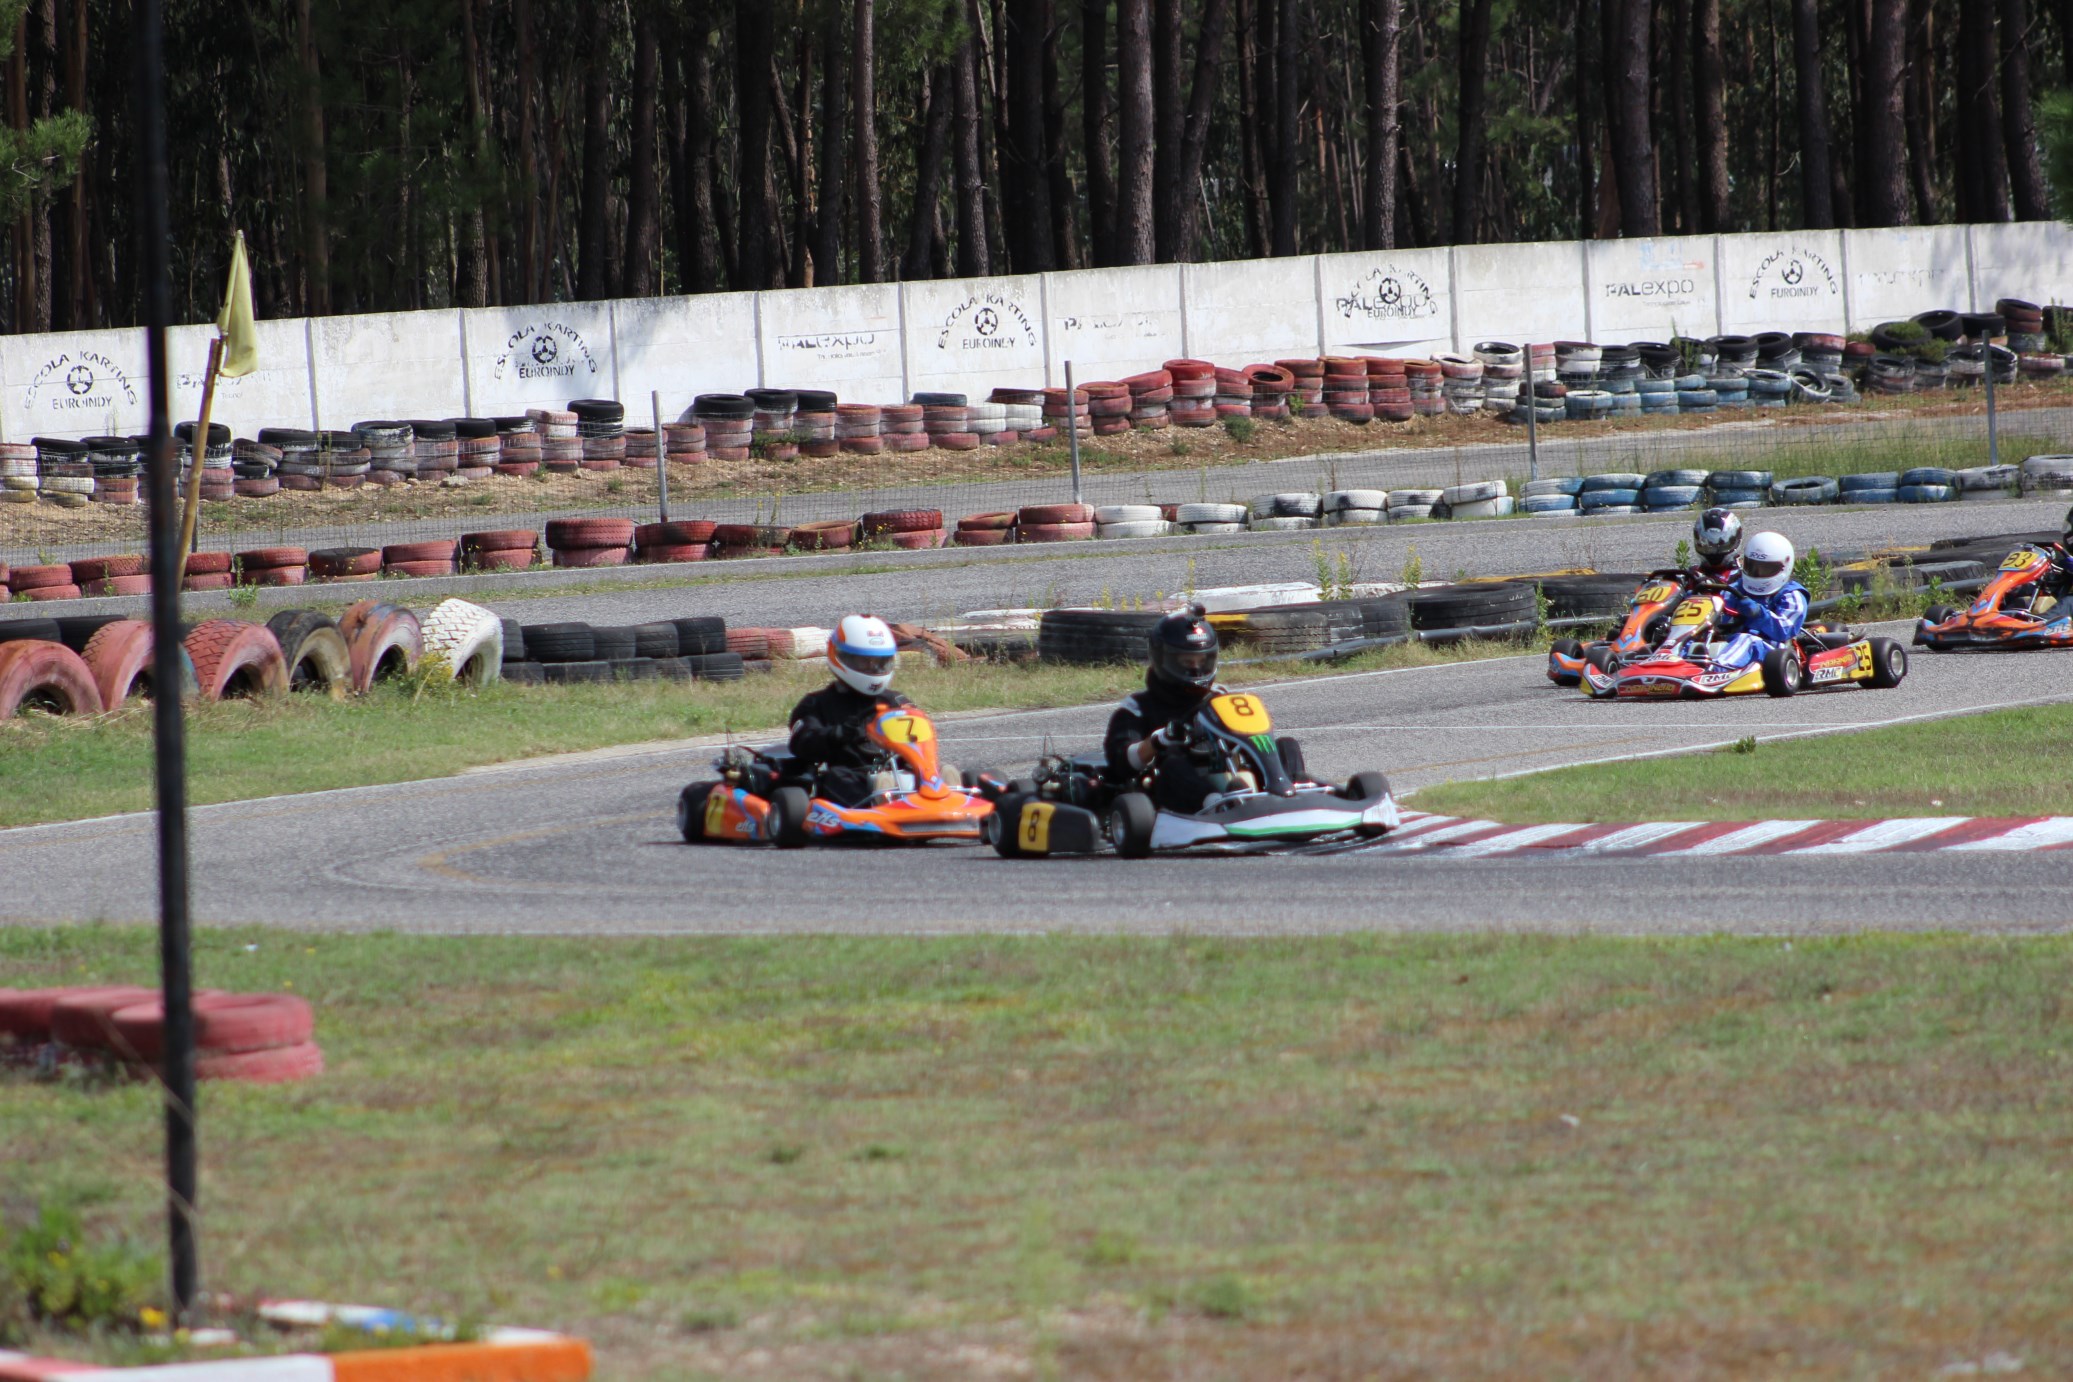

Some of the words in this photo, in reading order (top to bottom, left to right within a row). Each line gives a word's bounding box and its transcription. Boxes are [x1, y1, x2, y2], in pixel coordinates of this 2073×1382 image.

[937, 296, 978, 349] ESCOLA
[986, 294, 1037, 346] KARTING
[544, 321, 598, 373] KARTING
[79, 350, 138, 405] KARTING
[518, 364, 575, 379] EUROINDY
[2002, 552, 2033, 568] 93
[1675, 602, 1702, 619] 25
[1856, 644, 1872, 672] 25
[1229, 696, 1255, 716] 8
[896, 717, 915, 738] 7
[1027, 809, 1040, 843] 8
